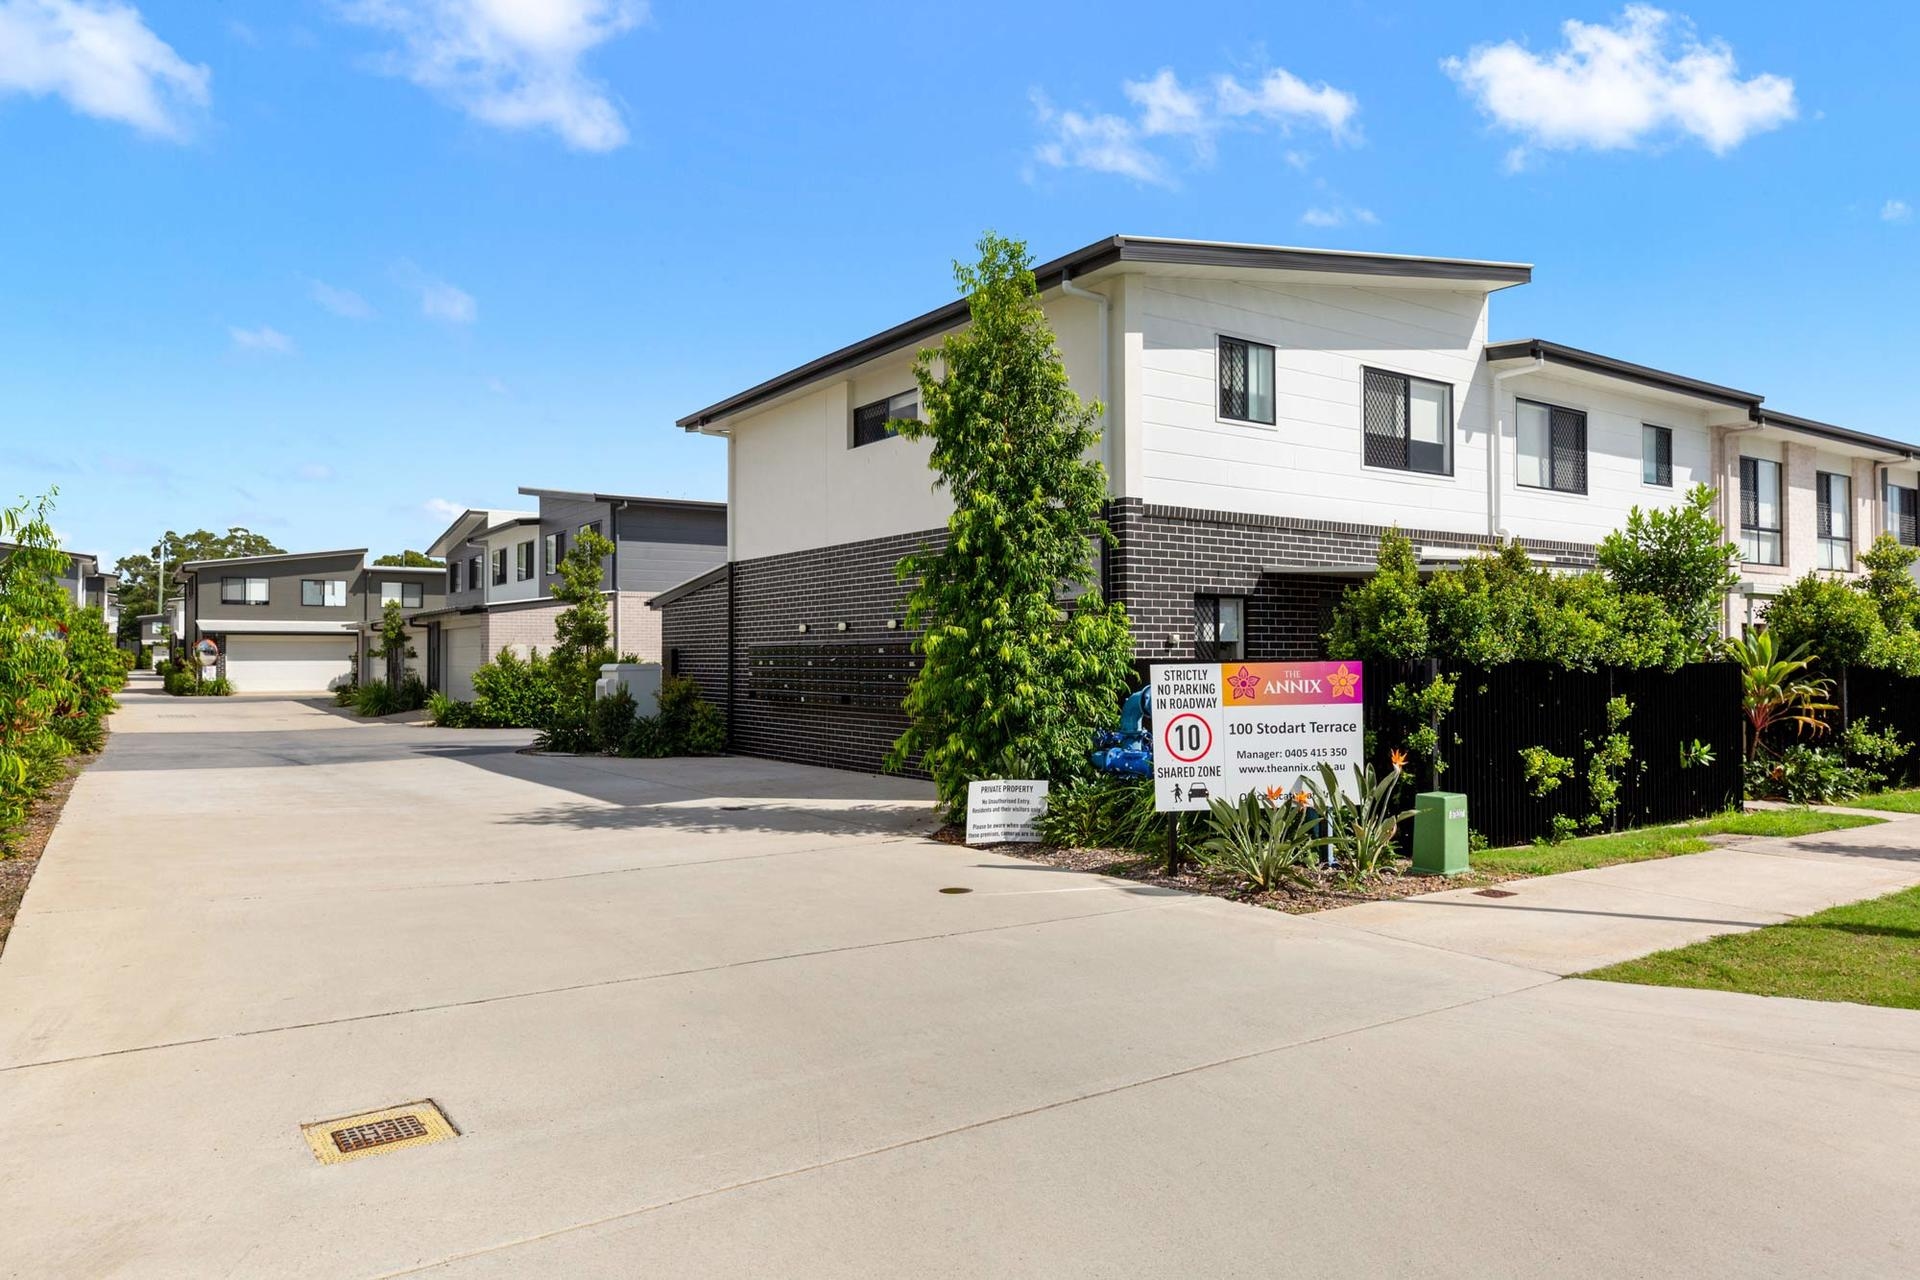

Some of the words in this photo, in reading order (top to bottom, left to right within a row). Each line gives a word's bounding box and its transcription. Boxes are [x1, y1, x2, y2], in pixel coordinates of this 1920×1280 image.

[1164, 670, 1208, 681] STRICTLY
[1284, 670, 1300, 678] THE
[1158, 684, 1170, 695] NO
[1174, 683, 1216, 695] PARKING
[1264, 680, 1322, 694] ANNIX
[1156, 698, 1166, 709] IN
[1170, 697, 1217, 709] ROADWAY
[1229, 723, 1253, 735] 100
[1257, 722, 1306, 734] Stodart
[1309, 722, 1357, 733] Terrace
[1175, 724, 1200, 751] 10
[1236, 750, 1282, 760] Manager:
[1284, 749, 1308, 758] 0405
[1310, 748, 1328, 757] 415
[1330, 748, 1347, 756] 350
[1158, 767, 1195, 778] SHARED
[1198, 766, 1221, 777] ZONE
[981, 785, 1001, 794] PRIVATE
[1003, 784, 1033, 793] PROPERTY
